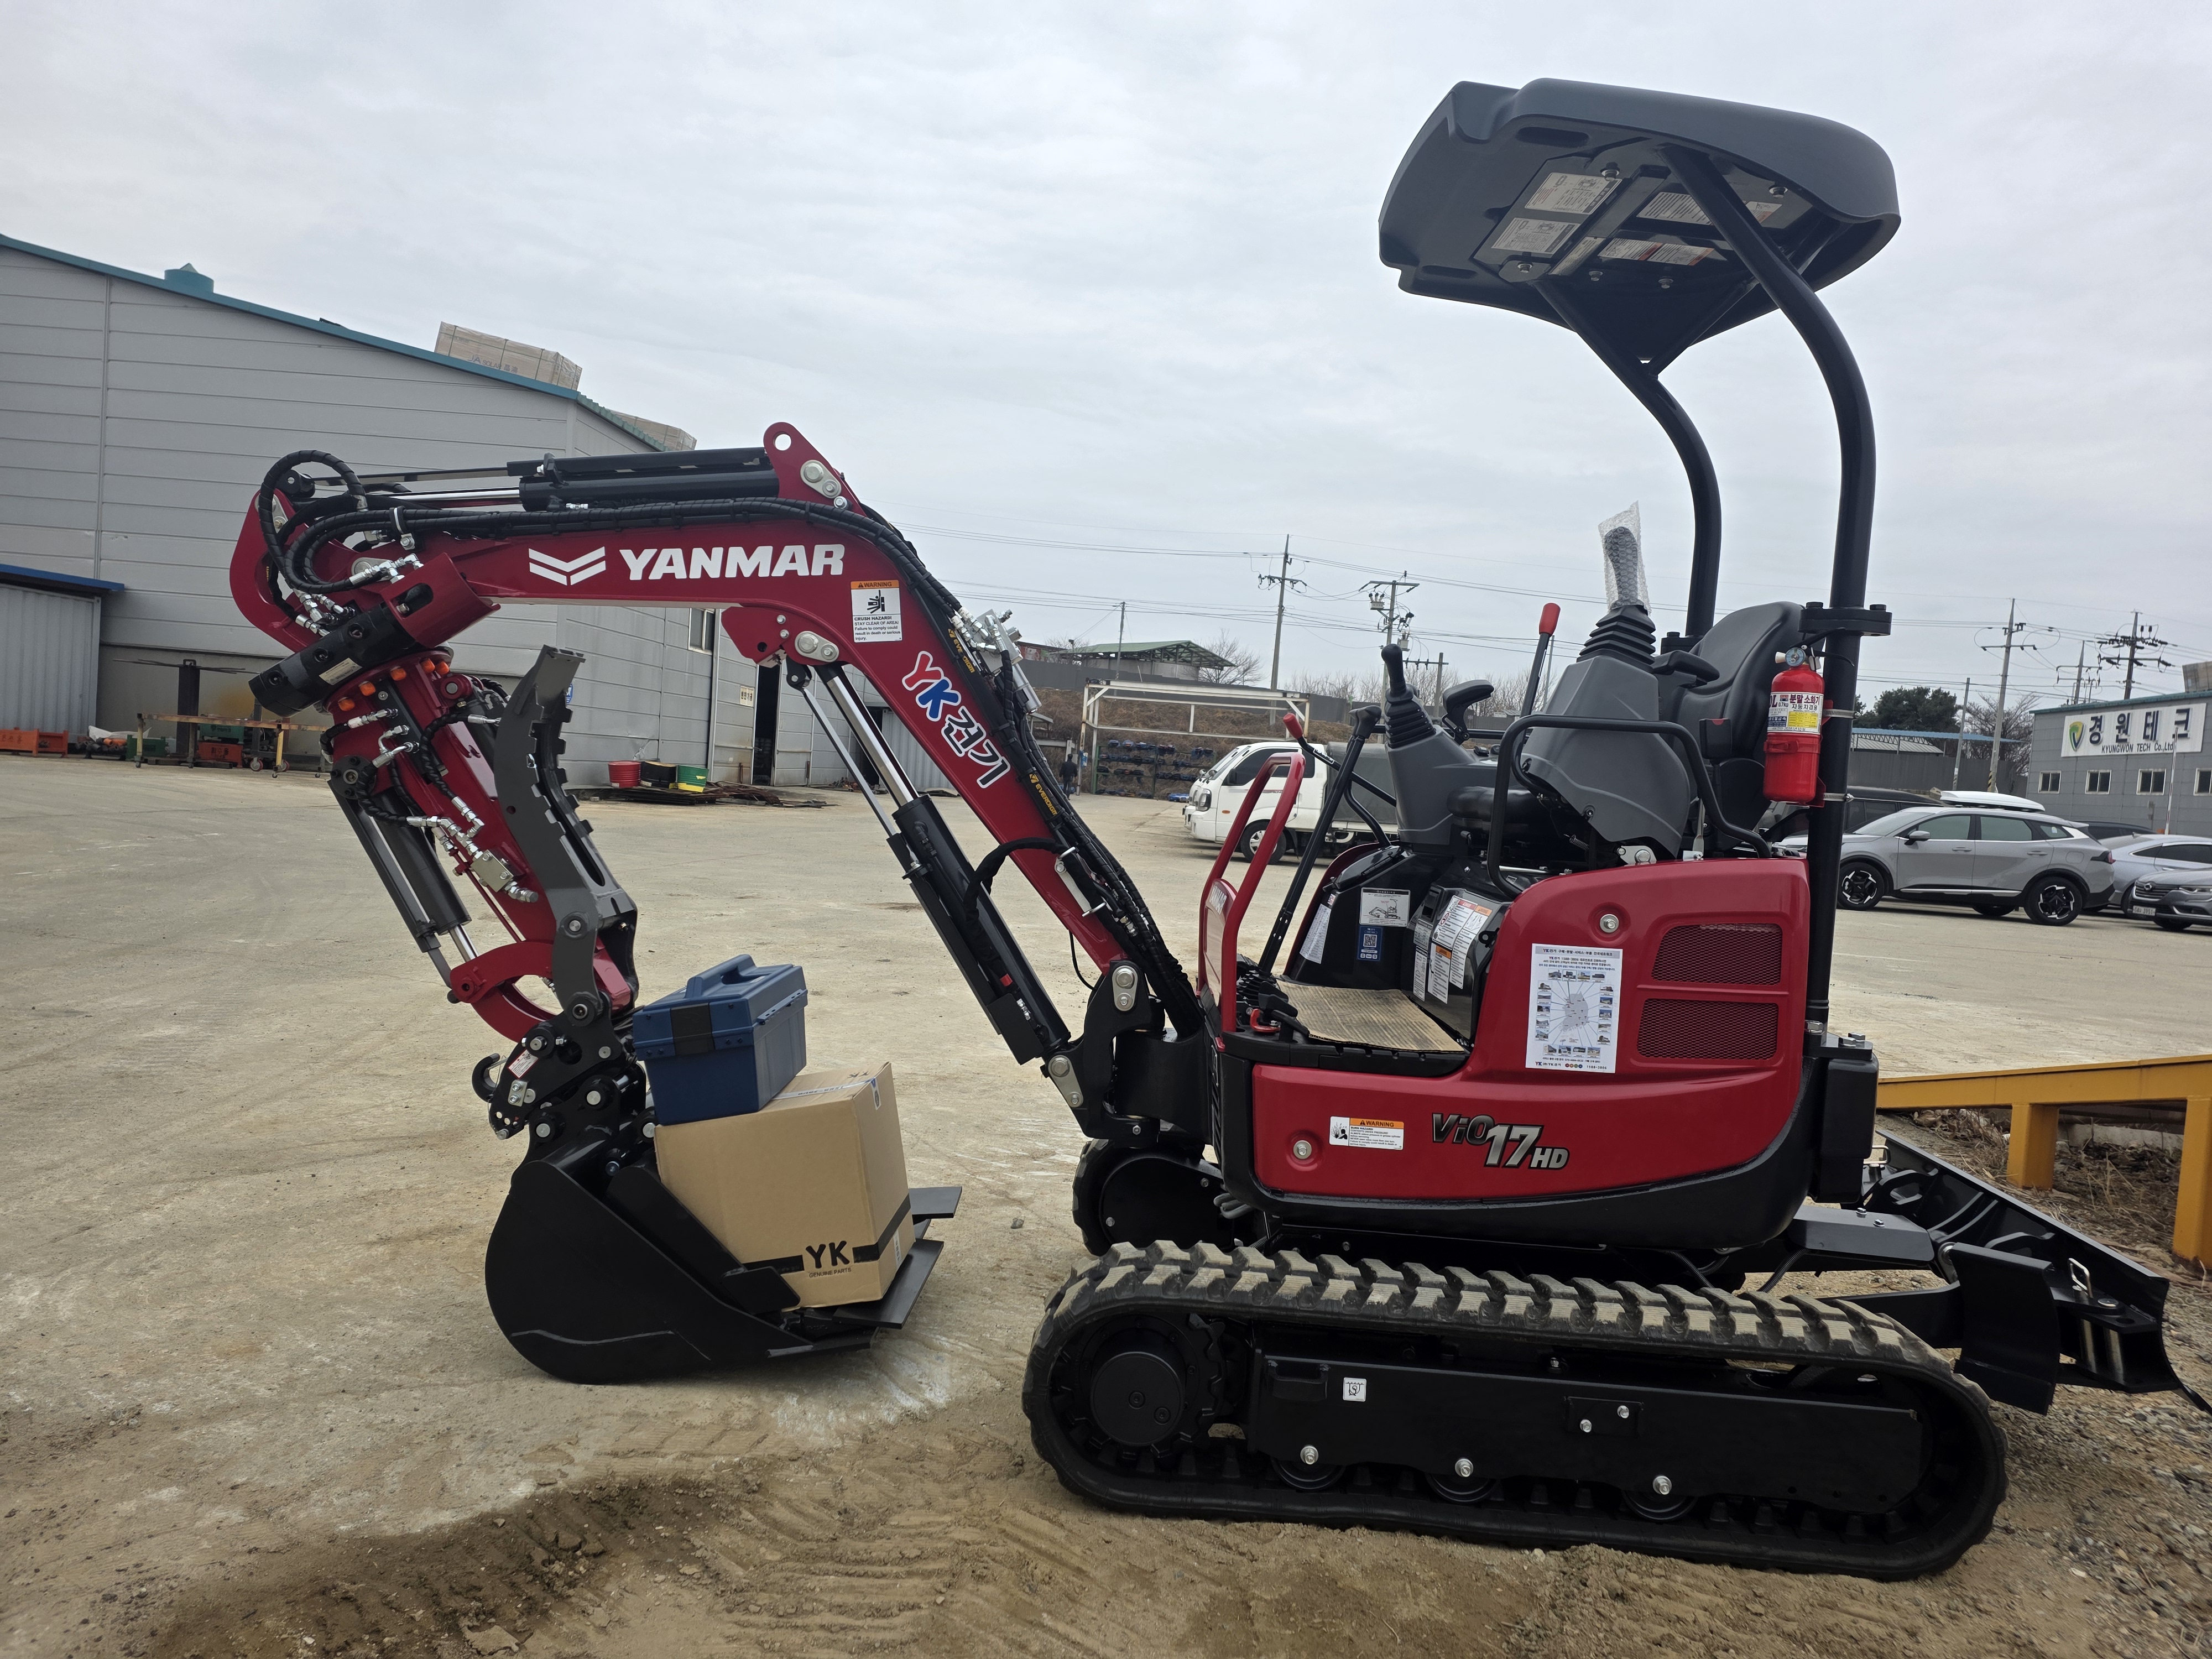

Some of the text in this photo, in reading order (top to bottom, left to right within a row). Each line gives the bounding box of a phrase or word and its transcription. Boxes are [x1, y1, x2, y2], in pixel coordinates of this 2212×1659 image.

[619, 544, 845, 580] YANMAR
[1790, 694, 1820, 705] 분말 소화기
[2089, 708, 2190, 744] 경원테크
[2101, 744, 2133, 753] KYUNGWON
[2137, 743, 2151, 752] TECH
[1528, 1146, 1571, 1170] HD
[805, 1240, 850, 1269] YK
[809, 1270, 833, 1279] GENUINE
